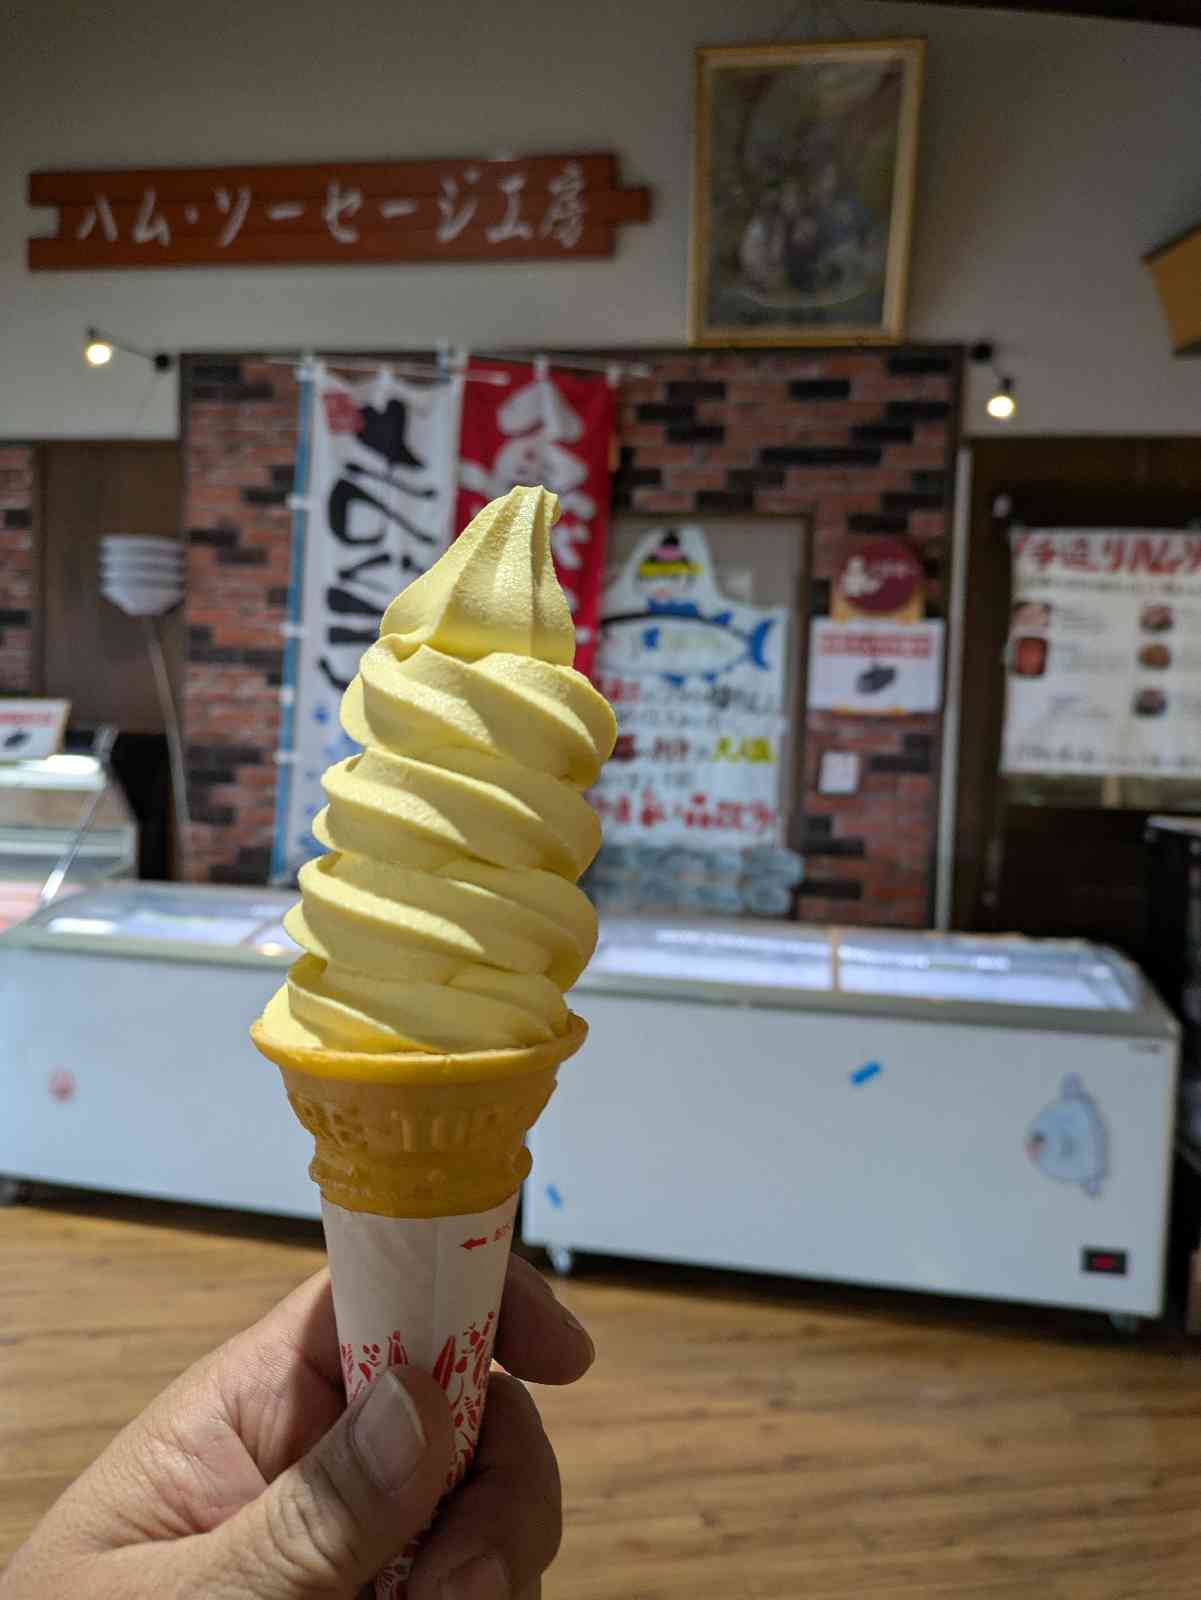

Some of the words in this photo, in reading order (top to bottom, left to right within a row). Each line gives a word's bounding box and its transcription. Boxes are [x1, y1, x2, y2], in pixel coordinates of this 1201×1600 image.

[77, 162, 586, 247] ハム・ソーセージ工房
